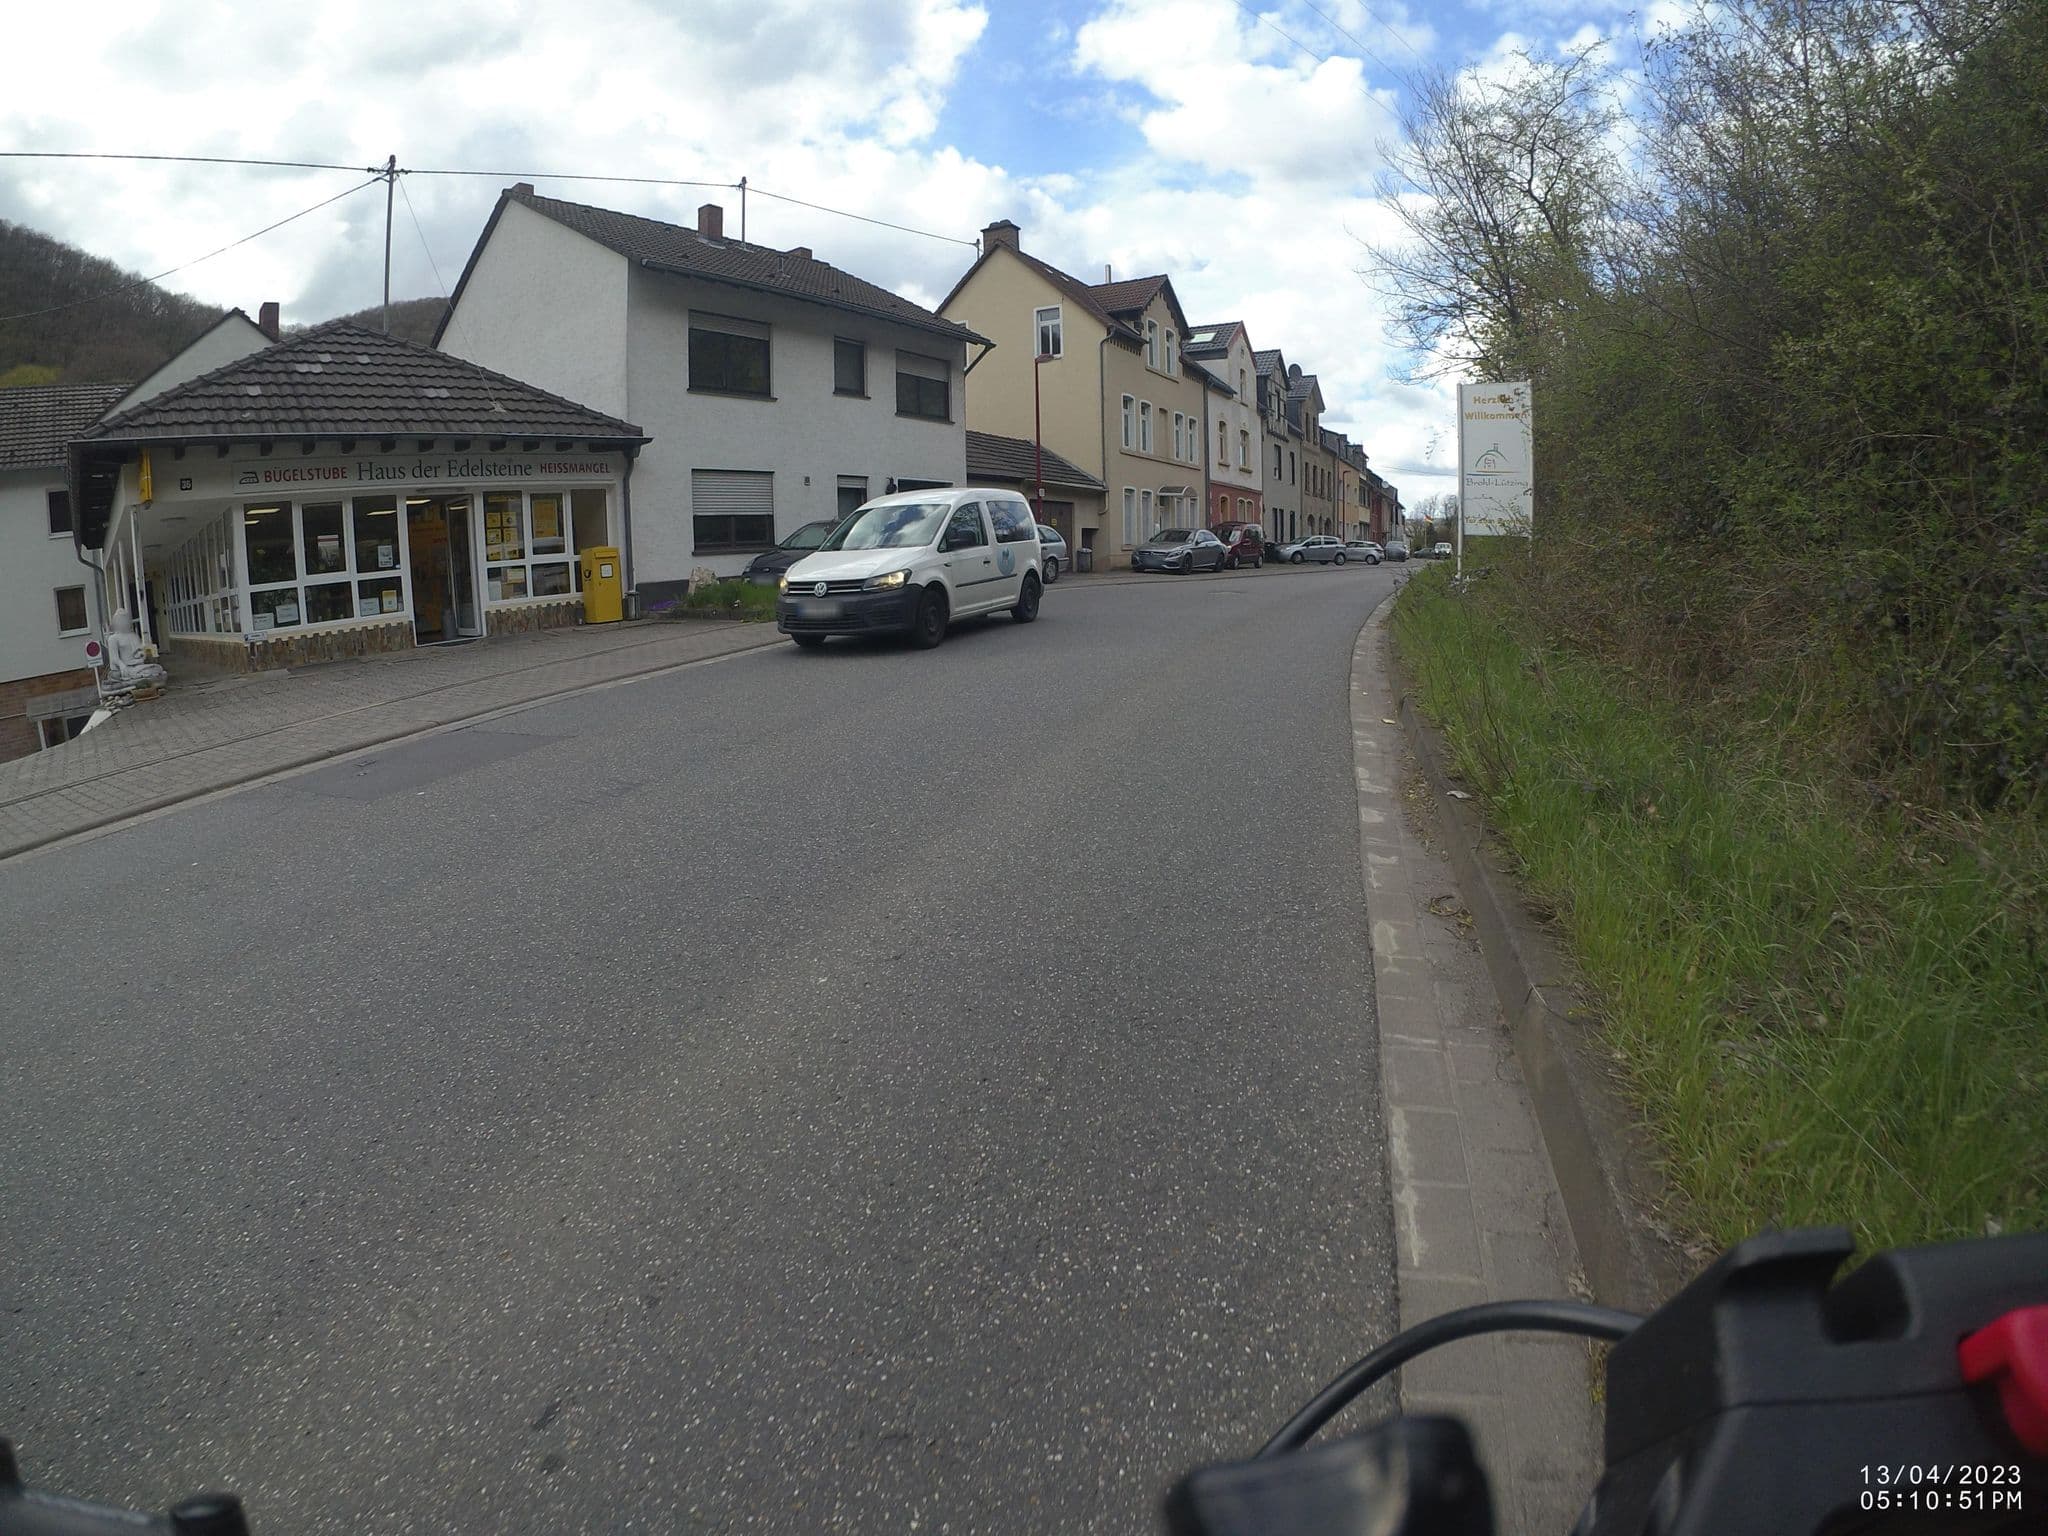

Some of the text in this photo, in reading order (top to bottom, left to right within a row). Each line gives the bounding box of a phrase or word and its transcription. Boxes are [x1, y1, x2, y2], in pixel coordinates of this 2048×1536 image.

[263, 458, 610, 484] BÜGELSTUBE Haus der Edelsteine HEISSMANGEL
